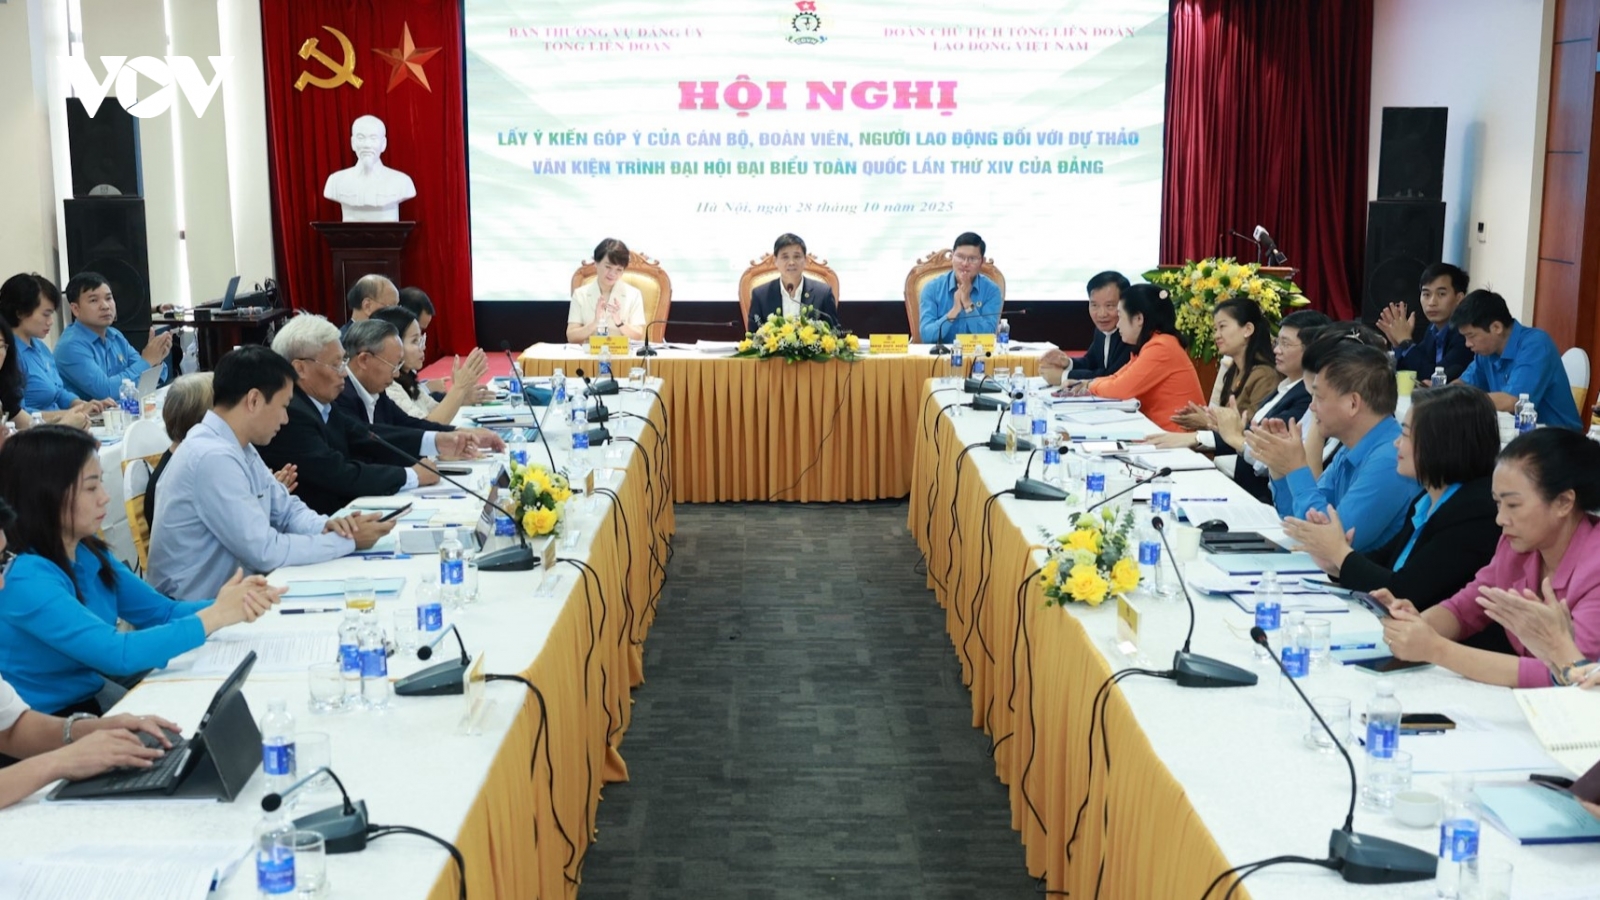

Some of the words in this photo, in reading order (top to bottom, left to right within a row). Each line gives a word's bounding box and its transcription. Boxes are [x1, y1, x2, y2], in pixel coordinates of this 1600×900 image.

[509, 28, 539, 38] BAN
[932, 41, 965, 51] LAO
[1054, 41, 1089, 51] NAM
[678, 74, 787, 118] HỘI
[806, 81, 958, 116] NGHỊ
[498, 126, 528, 146] LẤY
[533, 129, 544, 146] Ý
[548, 127, 588, 146] KIẾN
[594, 130, 627, 146] GÓP
[633, 129, 643, 146] Ý
[647, 127, 682, 146] CỦA
[687, 130, 722, 146] CÁN
[727, 129, 755, 149] BỘ,
[759, 130, 806, 146] ĐOÀN
[811, 130, 854, 148] VIÊN,
[859, 128, 911, 146] NGƯỜI
[916, 132, 947, 146] LAO
[951, 129, 999, 148] ĐỘNG
[1003, 127, 1032, 146] ĐỐI
[1037, 129, 1064, 146] VỚI
[1068, 130, 1093, 149] DỰ
[1096, 127, 1140, 146] THẢO
[532, 158, 567, 175] VĂN
[571, 158, 612, 177] KIỆN
[616, 158, 666, 175] TRÌNH
[670, 161, 699, 178] ĐẠI
[704, 158, 732, 178] HỘI
[737, 161, 765, 178] ĐẠI
[770, 155, 809, 175] BIỂU
[813, 158, 858, 175] TOÀN
[862, 155, 907, 176] QUỐC
[950, 158, 984, 175] THỨ
[987, 160, 1014, 175] XIV
[1019, 155, 1053, 175] CỦA
[1057, 155, 1104, 175] ĐẢNG
[696, 201, 718, 214] Hà
[756, 203, 792, 216] ngày
[796, 202, 813, 214] 28
[815, 201, 859, 216] tháng
[862, 202, 880, 213] 10
[883, 202, 916, 213] năm
[919, 201, 954, 213] 2025
